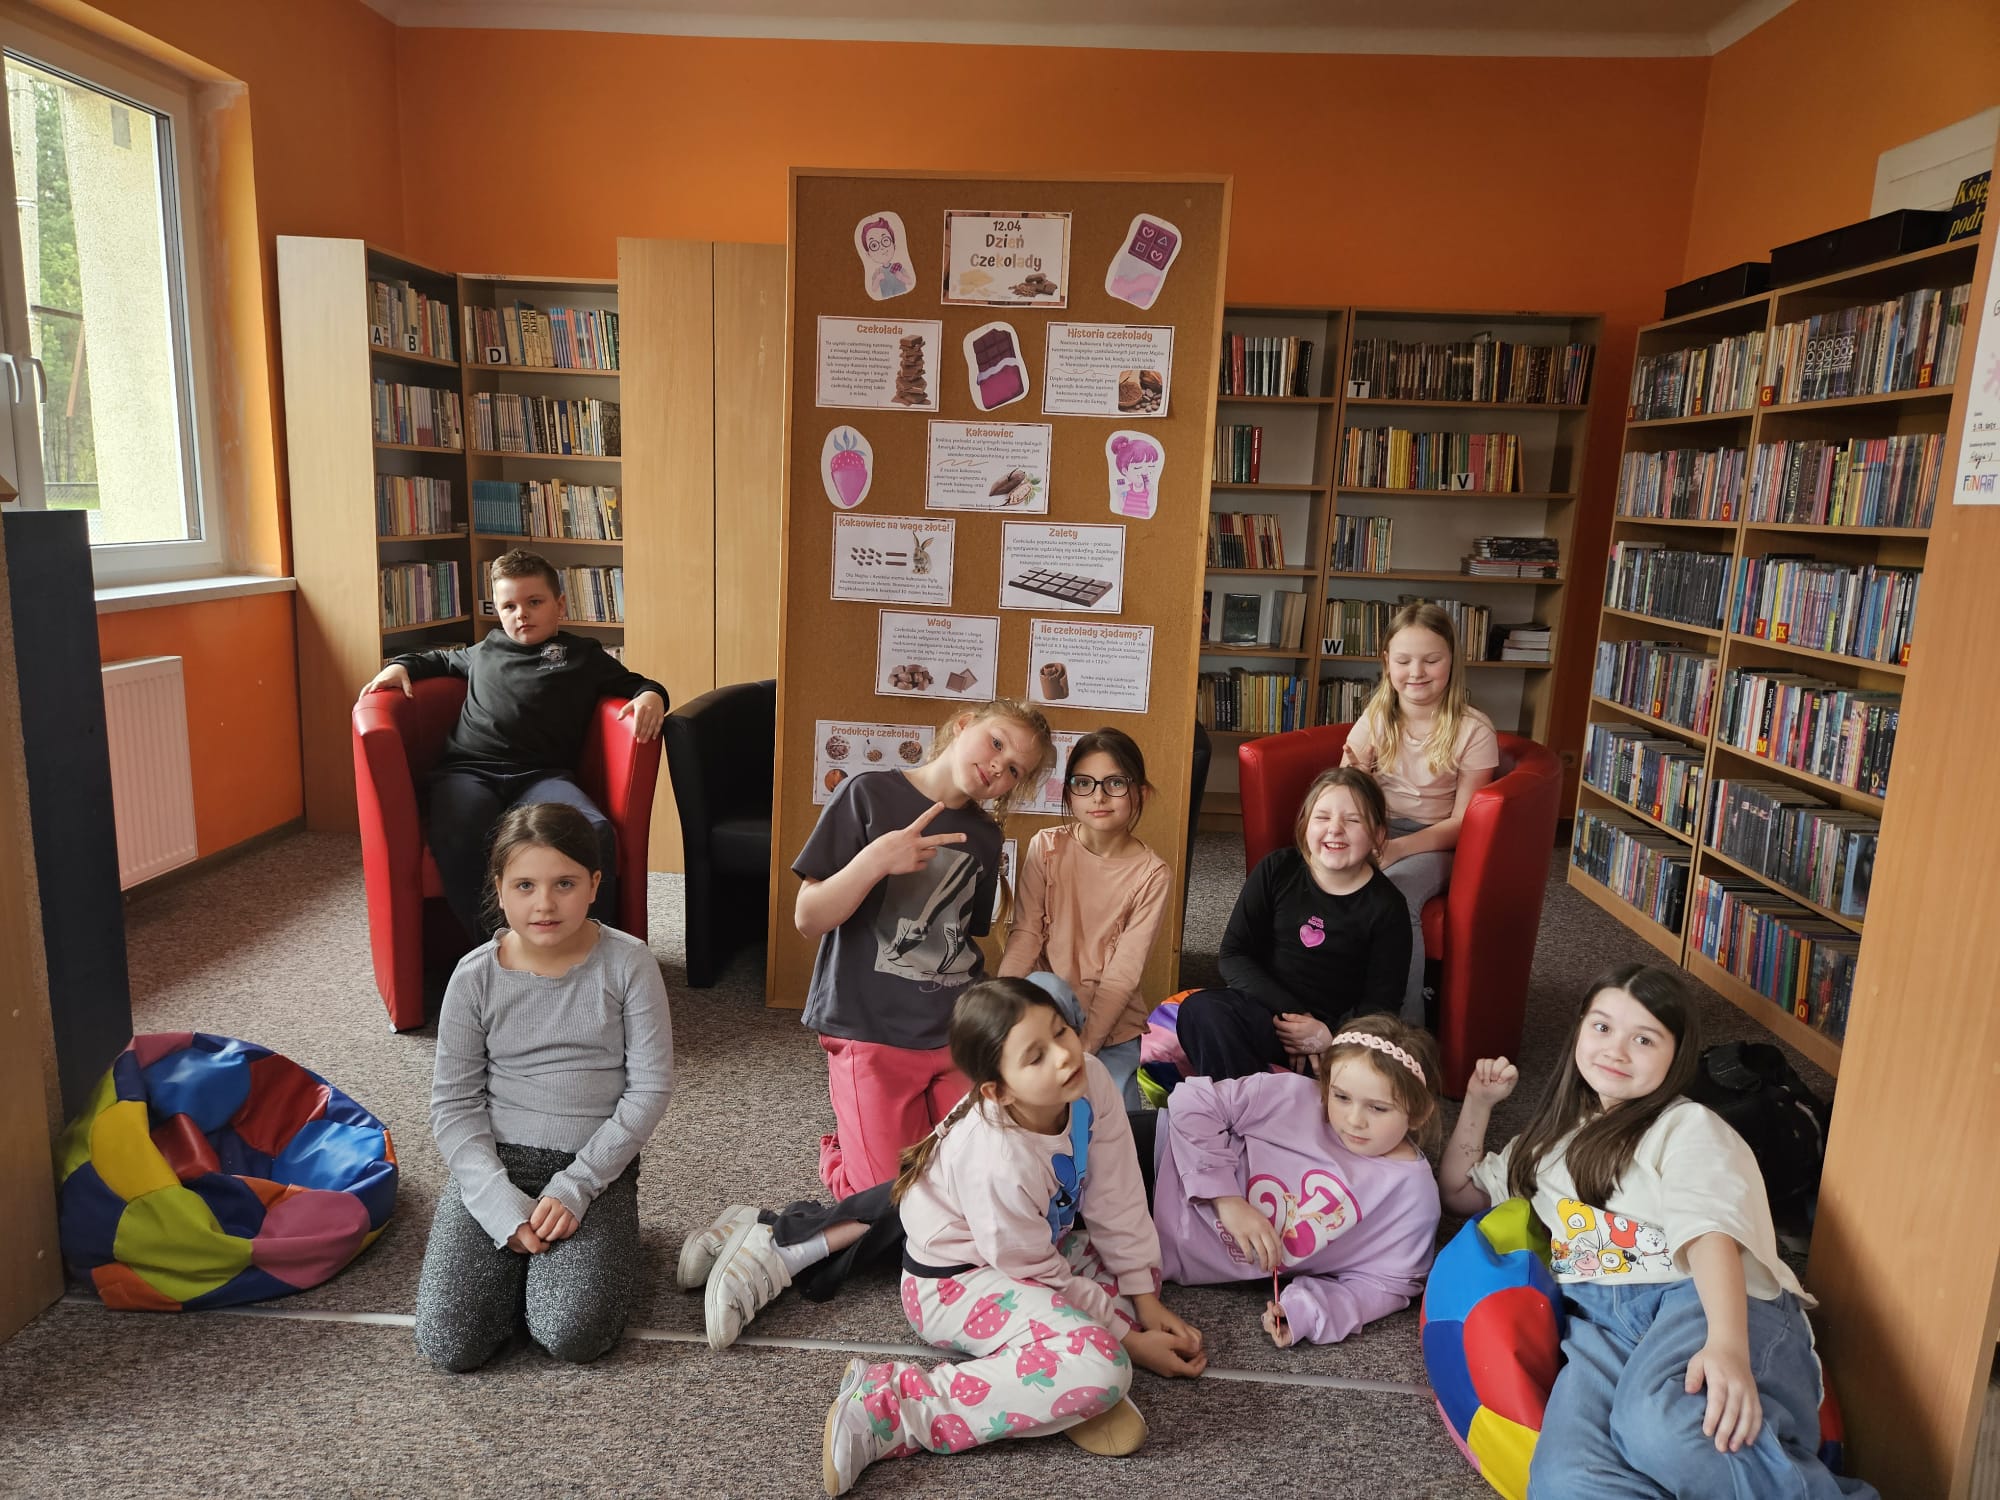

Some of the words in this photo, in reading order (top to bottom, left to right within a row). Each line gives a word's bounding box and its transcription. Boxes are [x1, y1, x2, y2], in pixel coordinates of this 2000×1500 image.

[993, 220, 1022, 232] 12.04
[985, 233, 1025, 249] Dzień
[970, 253, 1042, 272] Czekolady
[373, 327, 383, 345] A
[856, 324, 903, 335] Czekolada
[1067, 328, 1105, 340] Historia
[1106, 330, 1153, 342] czekolady
[408, 335, 417, 352] B
[489, 348, 502, 363] D
[1353, 381, 1366, 397] T
[1762, 388, 1771, 402] G
[965, 427, 1014, 438] Kakaowiec
[1457, 474, 1470, 489] V
[839, 517, 886, 529] Kakaowiec
[887, 521, 898, 530] na
[899, 522, 923, 533] wagę
[924, 522, 950, 533] złota!
[1048, 527, 1079, 540] Zalety
[483, 601, 494, 615] E
[927, 618, 952, 629] Wady
[1041, 624, 1052, 634] Ile
[1053, 625, 1098, 639] czekolady
[1099, 628, 1144, 641] zjadamy?
[1777, 625, 1787, 639] K
[1324, 639, 1342, 654] W
[831, 725, 875, 737] Produkcja
[876, 728, 920, 741] czekolady
